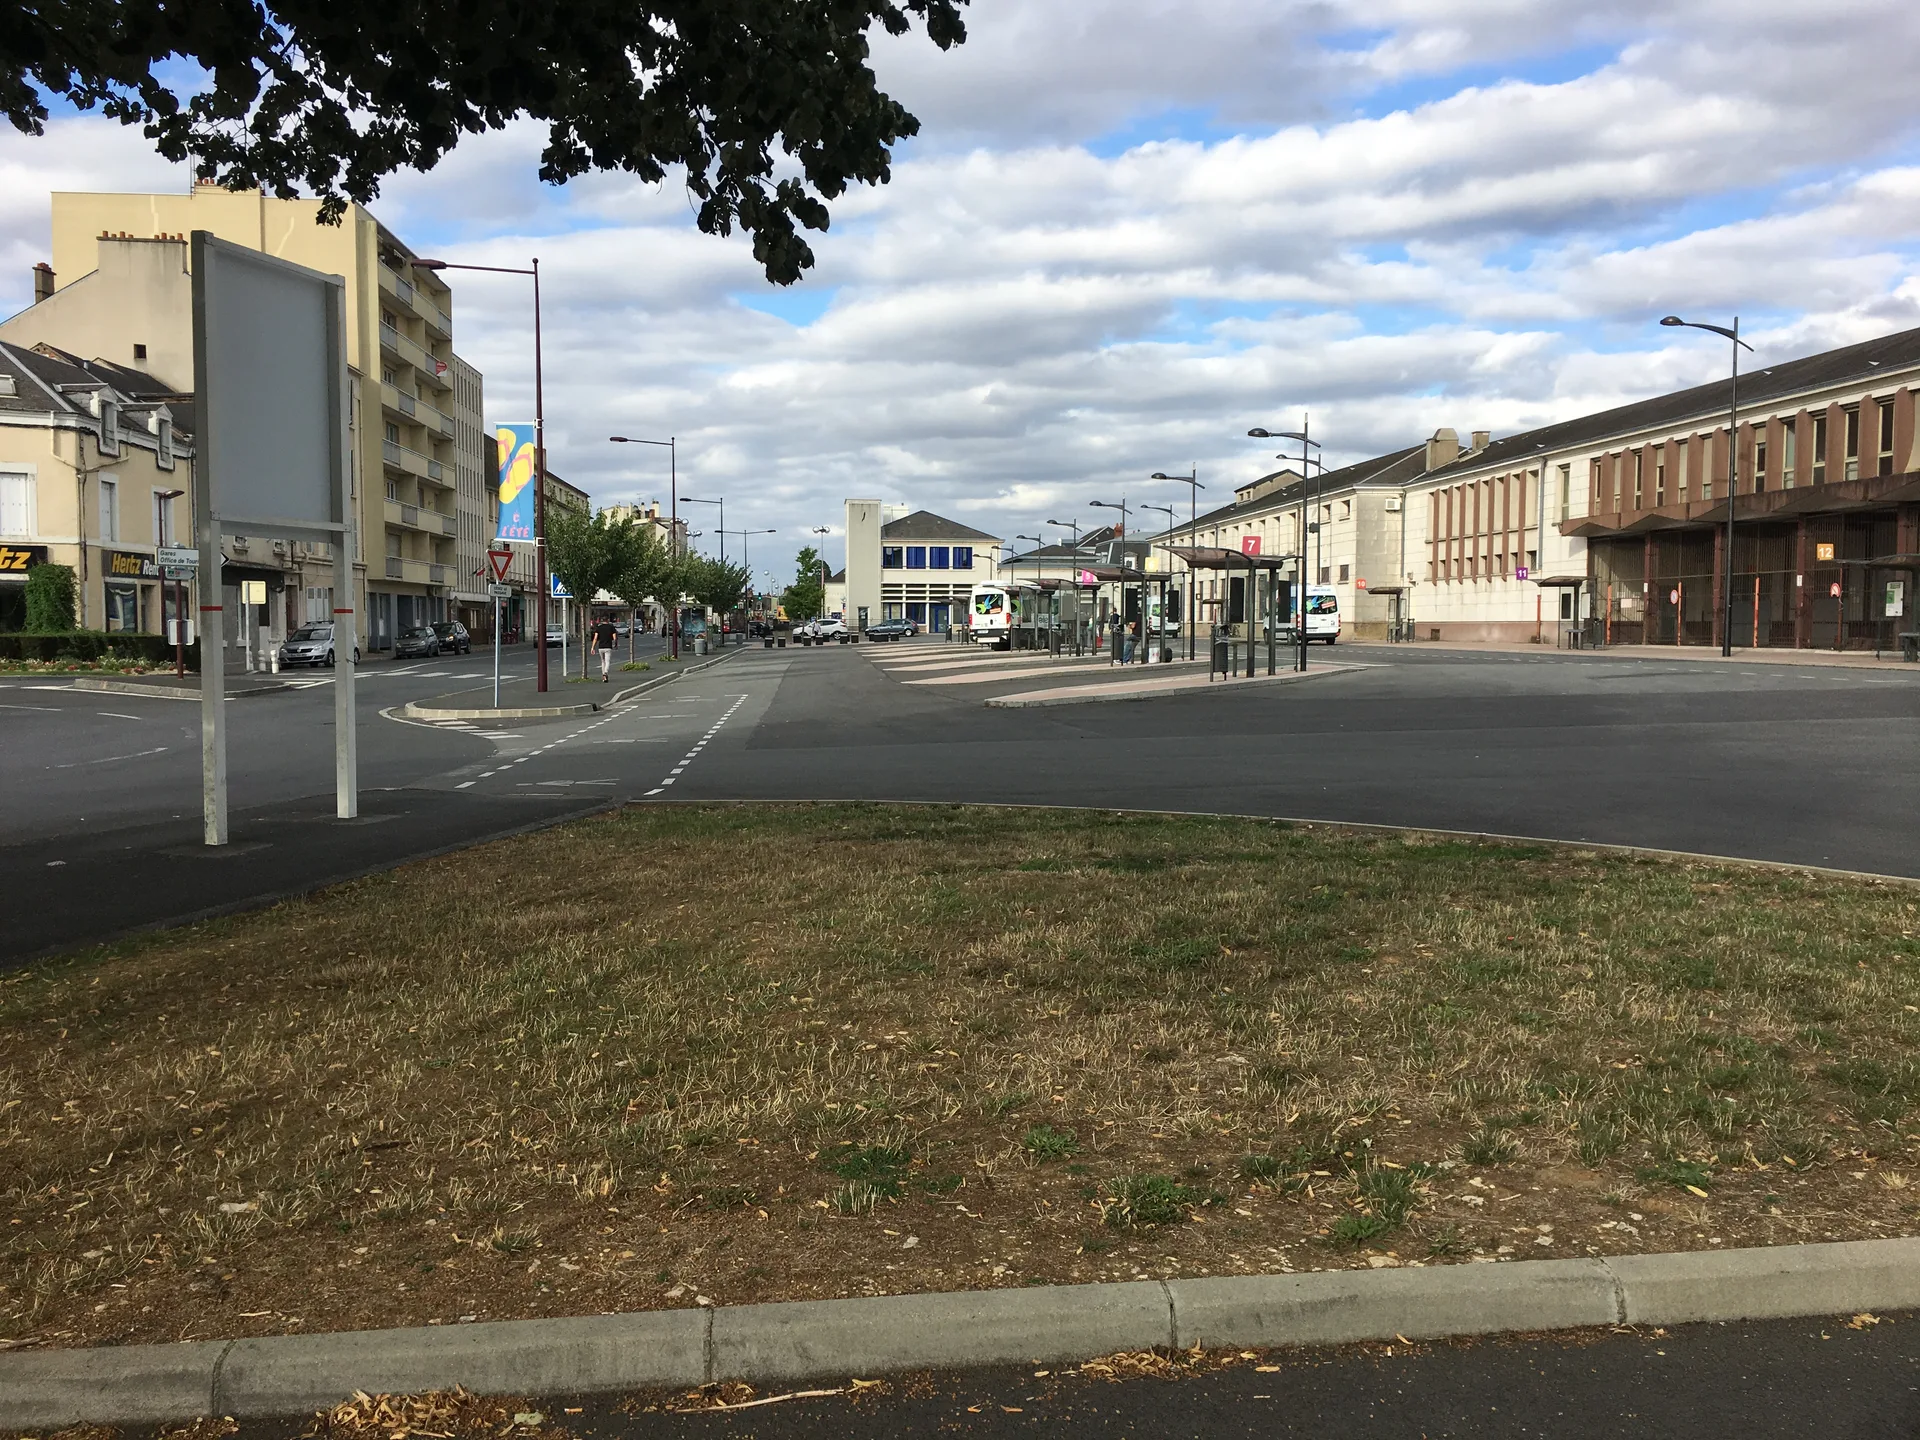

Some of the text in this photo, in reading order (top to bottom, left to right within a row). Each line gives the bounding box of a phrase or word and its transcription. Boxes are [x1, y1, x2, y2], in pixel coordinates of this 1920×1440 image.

[1247, 540, 1254, 551] 7
[1819, 547, 1832, 558] 12
[112, 554, 142, 575] Hertz
[1085, 572, 1091, 580] 5
